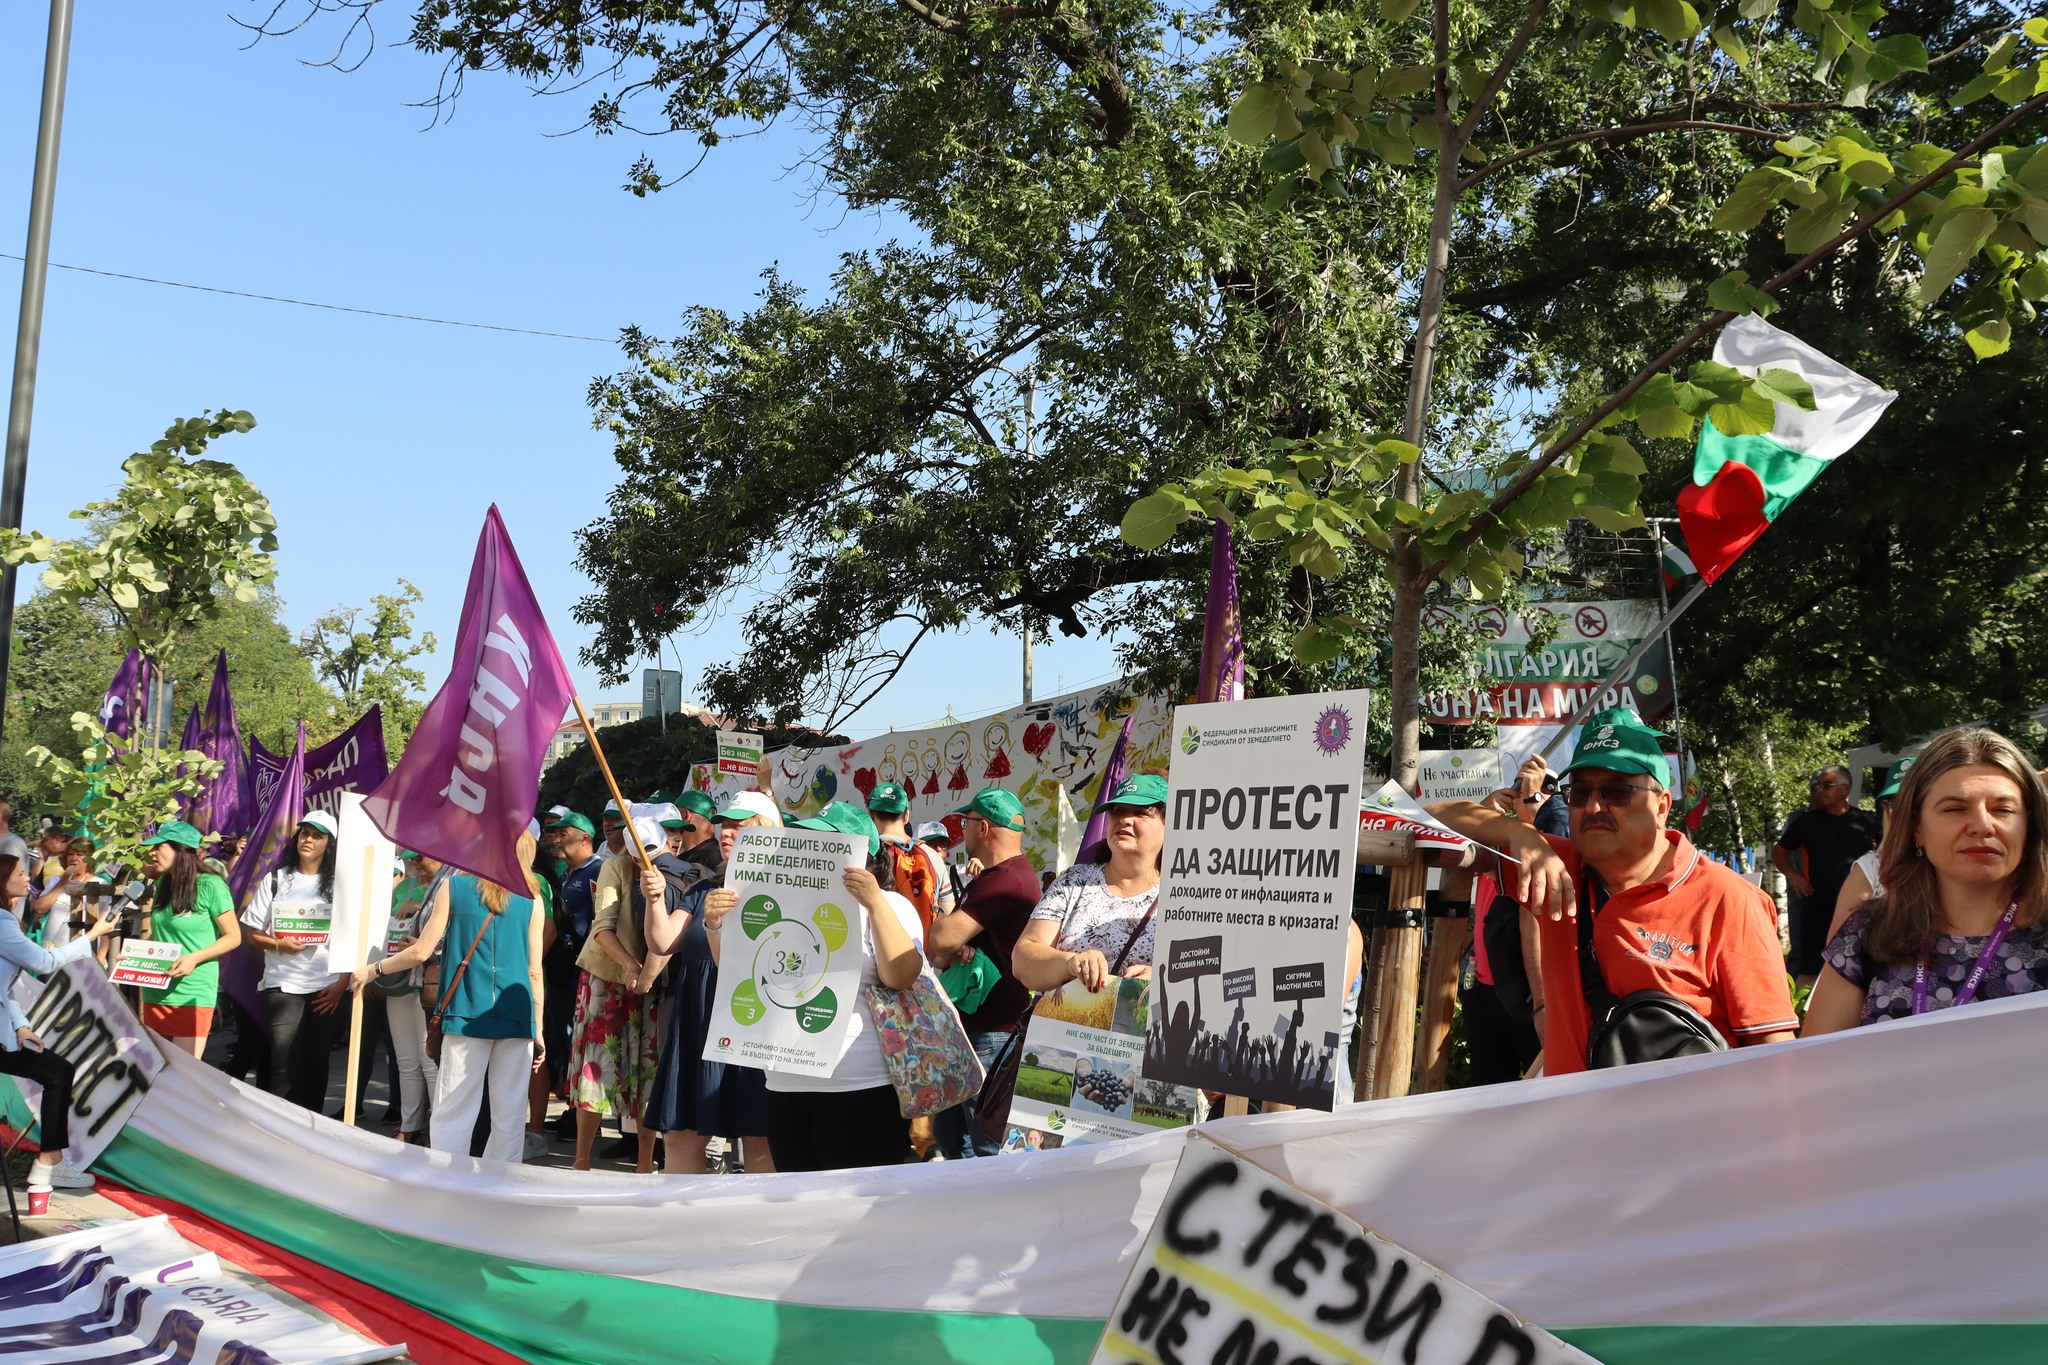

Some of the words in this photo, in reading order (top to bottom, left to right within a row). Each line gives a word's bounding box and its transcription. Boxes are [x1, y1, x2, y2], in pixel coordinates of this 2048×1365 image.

[1420, 688, 1493, 719] ОНА
[1502, 688, 1547, 719] НА
[1202, 728, 1238, 738] ФЕДЕРАЦИЯ
[1248, 724, 1298, 735] НЕЗАВИСИМИТЕ
[1202, 738, 1237, 747] СИНДИКАТИ
[1237, 737, 1246, 745] ОТ
[1247, 734, 1292, 744] ЗЕМЕДЕЛИЕТО
[1583, 739, 1620, 751] ФНСЗ
[720, 746, 735, 757] Без
[736, 751, 755, 760] нас...
[720, 763, 737, 771] ...не
[738, 766, 758, 774] може
[1423, 768, 1437, 781] Не
[1173, 784, 1349, 830] ПРОТЕСТ
[1360, 818, 1386, 831] не
[741, 835, 819, 852] РАБОТЕЩИТЕ
[821, 841, 852, 855] ХОРА
[736, 851, 745, 863] В
[748, 852, 836, 872] ЗЕМЕДЕЛИЕТО
[1170, 847, 1200, 879] ДА
[1207, 847, 1340, 881] ЗАЩИТИМ
[734, 869, 771, 883] ИМАТ
[775, 873, 829, 890] БЪДЕЩЕ!
[1169, 886, 1222, 900] доходите
[1225, 887, 1239, 900] от
[1241, 886, 1320, 904] инфлацията
[1323, 891, 1333, 904] и
[763, 900, 775, 912] Ф
[820, 907, 829, 918] Н
[2003, 901, 2018, 923] КНСБ
[275, 919, 293, 929] Без
[296, 922, 323, 930] нас...
[1164, 906, 1223, 923] работните
[1226, 911, 1264, 926] места
[1268, 914, 1276, 927] в
[1279, 914, 1339, 931] кризата!
[1636, 931, 1694, 957] TRADITION
[1180, 948, 1210, 960] ДОСТОЙНИ
[120, 958, 140, 967] Без
[140, 961, 165, 970] нас...
[1171, 960, 1196, 970] УСЛОВИЯ
[1196, 958, 1204, 967] НА
[1205, 956, 1220, 966] ТРУД
[136, 975, 168, 986] може!
[1223, 973, 1255, 986] ПО-ВИСОКИ
[1285, 971, 1312, 981] СИГУРНИ
[1967, 966, 1984, 989] КНСБ
[1228, 983, 1252, 996] ДОХОДИ!
[1276, 981, 1301, 992] РАБОТНИ
[1302, 980, 1323, 989] МЕСТА!
[1065, 1028, 1078, 1038] НИЕ
[1079, 1031, 1093, 1041] СМЕ
[1093, 1034, 1108, 1044] ЧАСТ
[1108, 1037, 1118, 1046] ОТ
[1118, 1039, 1146, 1052] ЗЕМЕДЕ
[742, 1041, 779, 1052] УСТОЙЧИВО
[780, 1046, 816, 1058] ЗЕМЕДЕЛИЕ
[1086, 1043, 1095, 1052] ЗА
[1095, 1045, 1133, 1059] БЪДЕЩЕТО!
[749, 1051, 783, 1062] БЪДЕЩЕТО
[792, 1056, 816, 1067] ЗЕМЯТА
[1070, 1117, 1100, 1128] ФЕДЕРАЦИЯ
[1108, 1126, 1145, 1136] НЕЗАВИСИМИ
[1071, 1124, 1101, 1134] СИНДИКАТИ
[1109, 1132, 1129, 1140] ЗЕМЕДЕ
[1163, 1161, 1240, 1256] С
[1242, 1189, 1443, 1365] ТЕЗИ
[1121, 1267, 1210, 1365] НЕ
